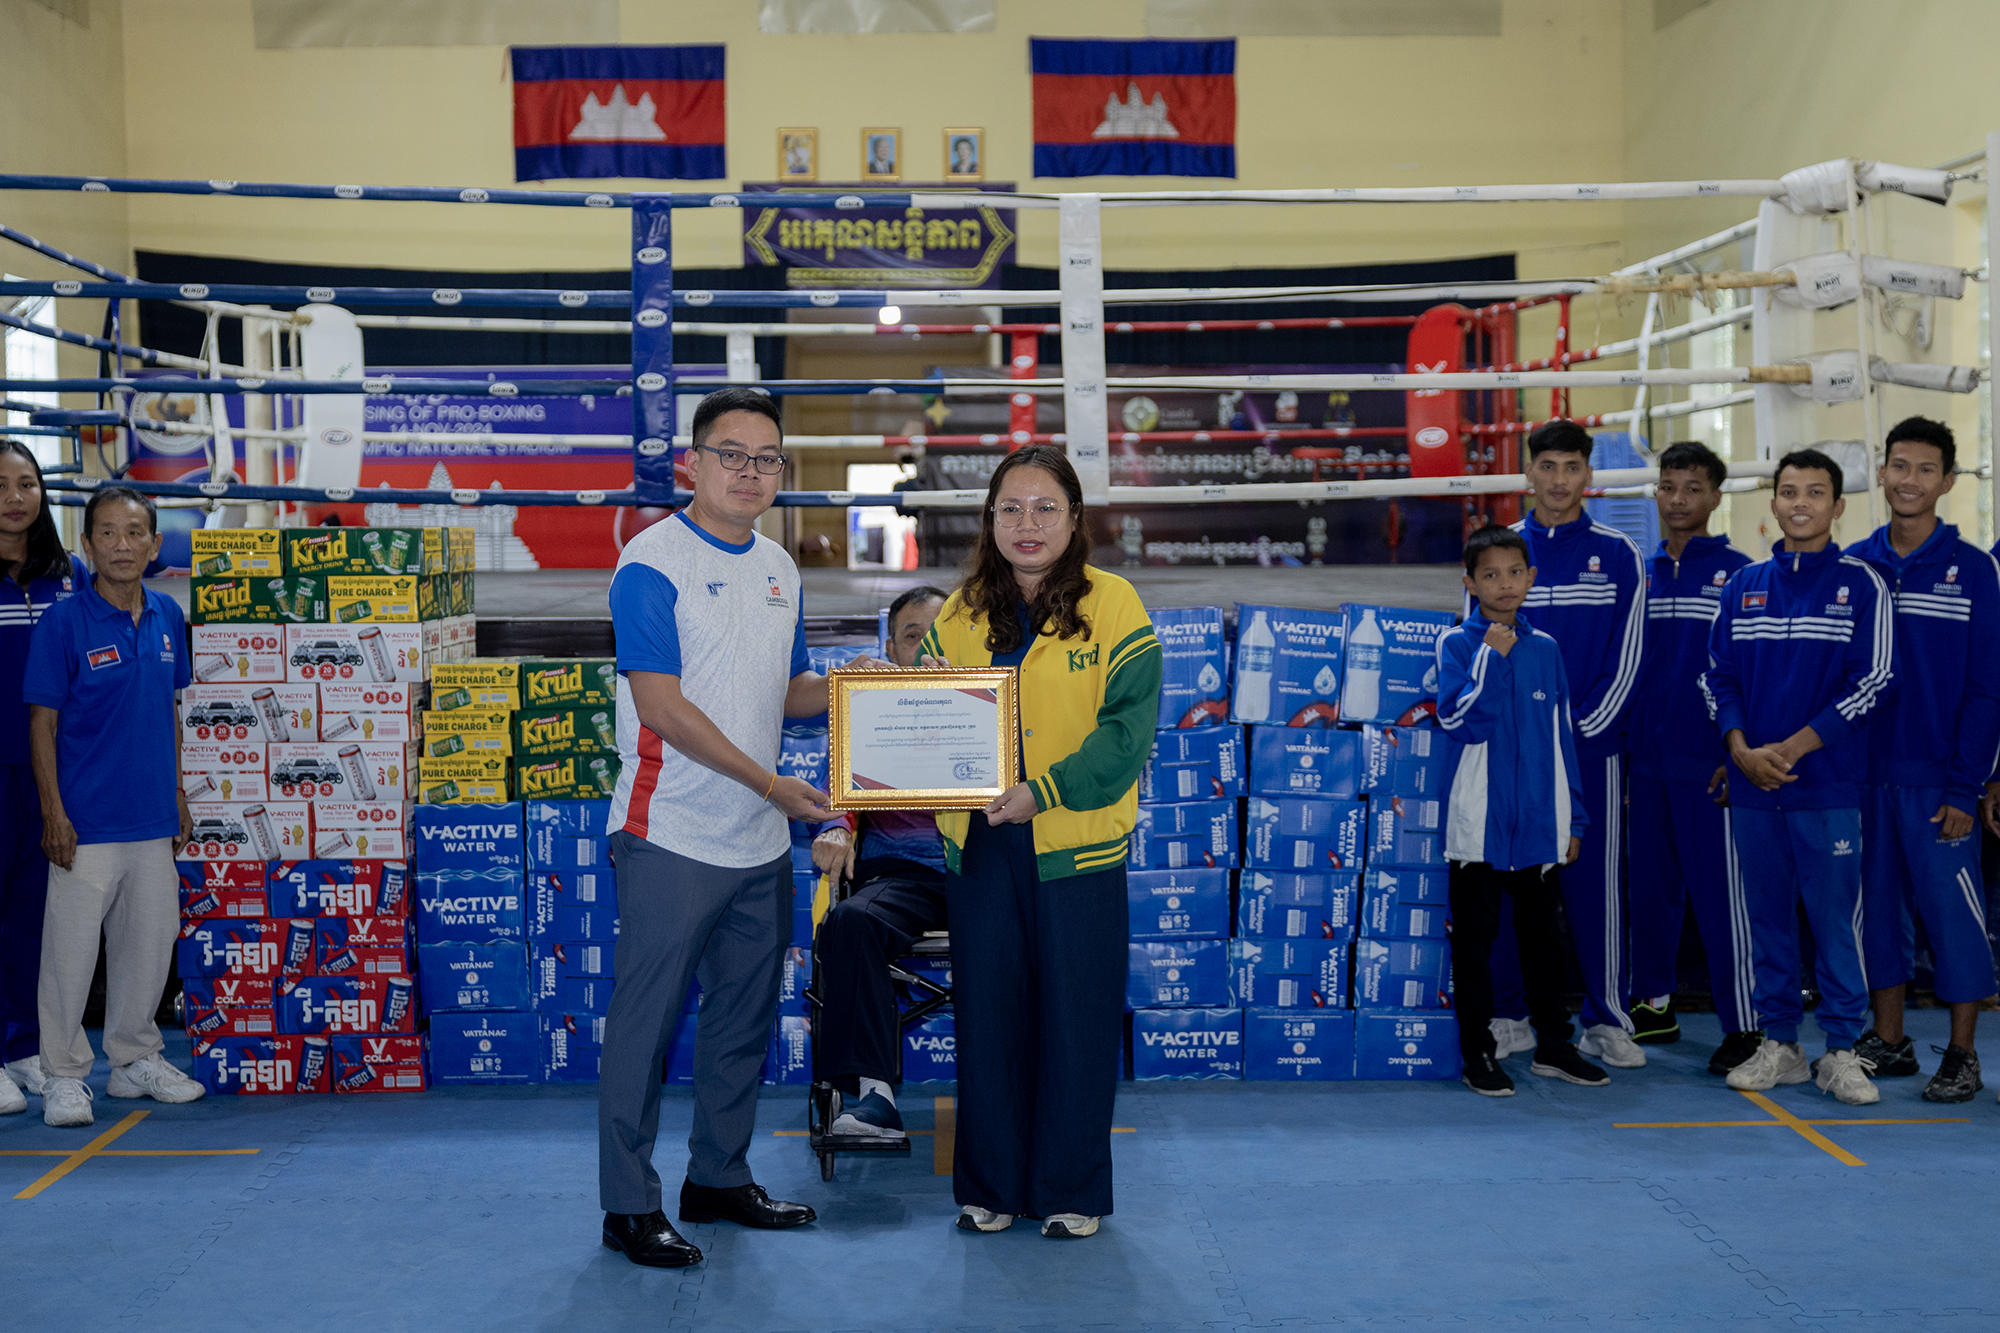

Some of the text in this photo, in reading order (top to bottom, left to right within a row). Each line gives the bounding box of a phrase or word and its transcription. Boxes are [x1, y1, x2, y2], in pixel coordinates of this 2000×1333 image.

[408, 406, 432, 422] OF
[437, 405, 546, 422] PRO-BOXING
[195, 540, 257, 550] PURE CHARGE
[290, 530, 348, 567] Krud
[196, 578, 252, 613] Krud
[330, 587, 393, 597] PURE CHARGE
[1272, 620, 1344, 638] V-ACTIVE
[1165, 635, 1205, 645] WATER
[1286, 634, 1327, 645] WATER
[1395, 633, 1435, 644] WATER
[1066, 643, 1100, 673] Krd
[435, 675, 496, 684] PURE CHARGE
[527, 664, 584, 700] Krud
[426, 722, 487, 731] PURE CHARGE
[520, 711, 576, 747] Krud
[1285, 744, 1330, 754] VATTANAC
[777, 752, 826, 767] V-AC
[1369, 729, 1382, 789] V-ACTIVE
[422, 769, 483, 777] PURE CHARGE
[519, 758, 577, 794] Krud
[420, 823, 519, 840] V-ACTIVE
[1338, 821, 1346, 854] WATER
[1345, 808, 1358, 867] V-ACTIVE
[443, 842, 497, 852] WATER
[205, 877, 236, 887] COLA
[1151, 886, 1196, 895] VATTANAC
[421, 896, 519, 913] V-ACTIVE
[537, 875, 547, 935] V-ACTIVE
[443, 914, 497, 925] WATER
[349, 934, 378, 943] COLA
[450, 961, 494, 970] VATTANAC
[1151, 958, 1195, 967] VATTANAC
[1328, 947, 1339, 1005] V-ACTIVE
[215, 995, 245, 1005] COLA
[463, 1029, 507, 1038] VATTANAC
[1142, 1031, 1240, 1046] V-ACTIVE
[908, 1036, 956, 1051] V-AC
[363, 1053, 393, 1063] COLA
[930, 1053, 957, 1063] WA
[1164, 1048, 1217, 1059] WATER
[1277, 1057, 1321, 1066] VATTANAC
[1388, 1057, 1432, 1066] VATTANAC
